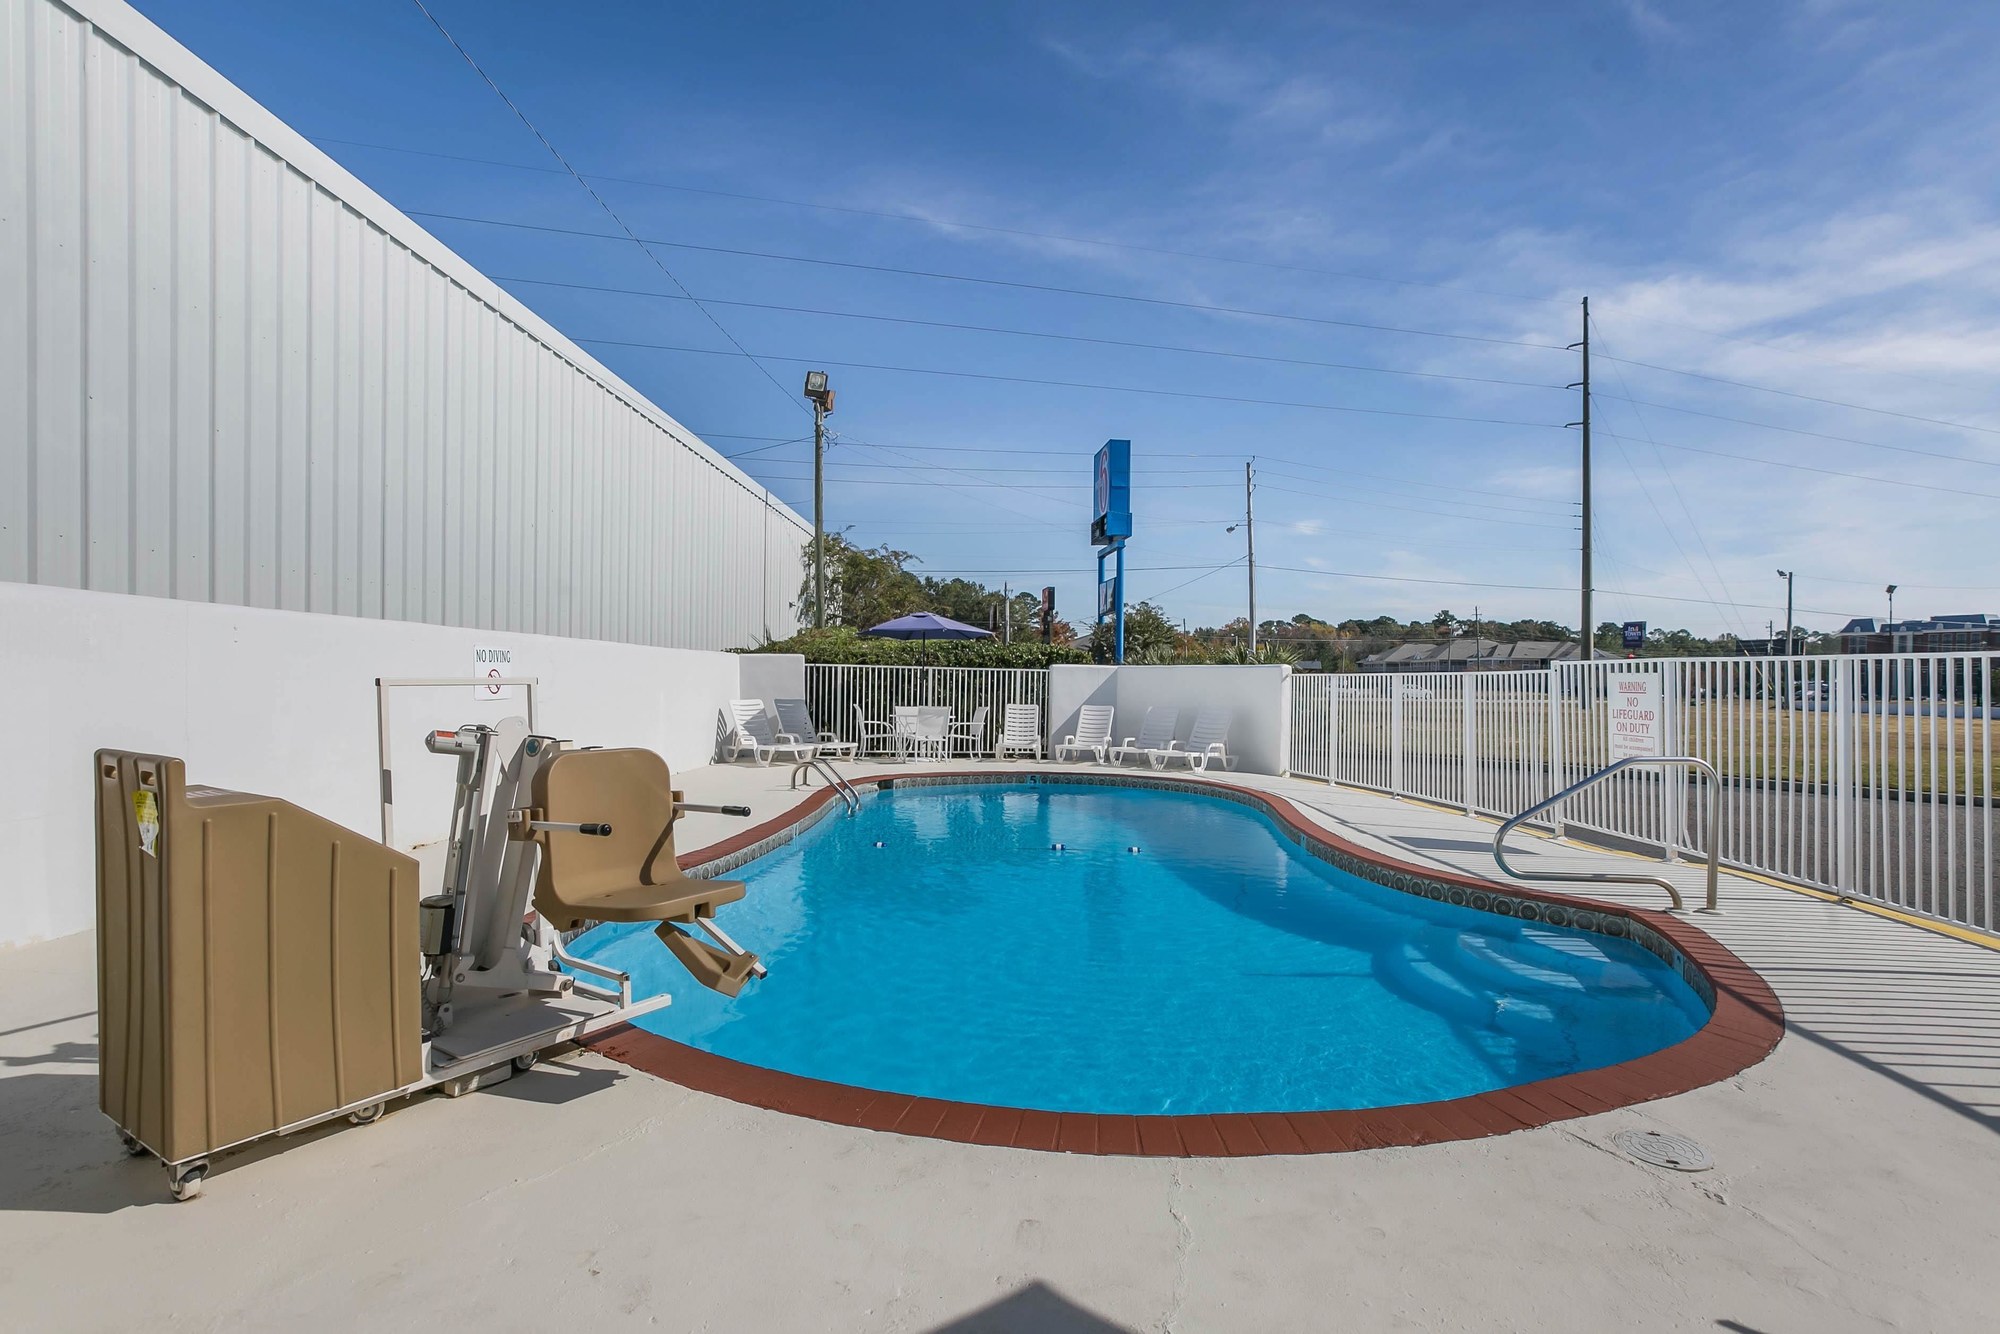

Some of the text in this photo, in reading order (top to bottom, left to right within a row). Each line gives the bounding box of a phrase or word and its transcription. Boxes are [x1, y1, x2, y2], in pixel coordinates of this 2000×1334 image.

[476, 649, 511, 663] NO DIVING
[1619, 681, 1647, 692] WARNING
[1627, 697, 1638, 707] NO
[1612, 709, 1654, 721] LIFEGUARD
[1616, 721, 1650, 734] ON DUTY
[1030, 775, 1037, 784] 5
